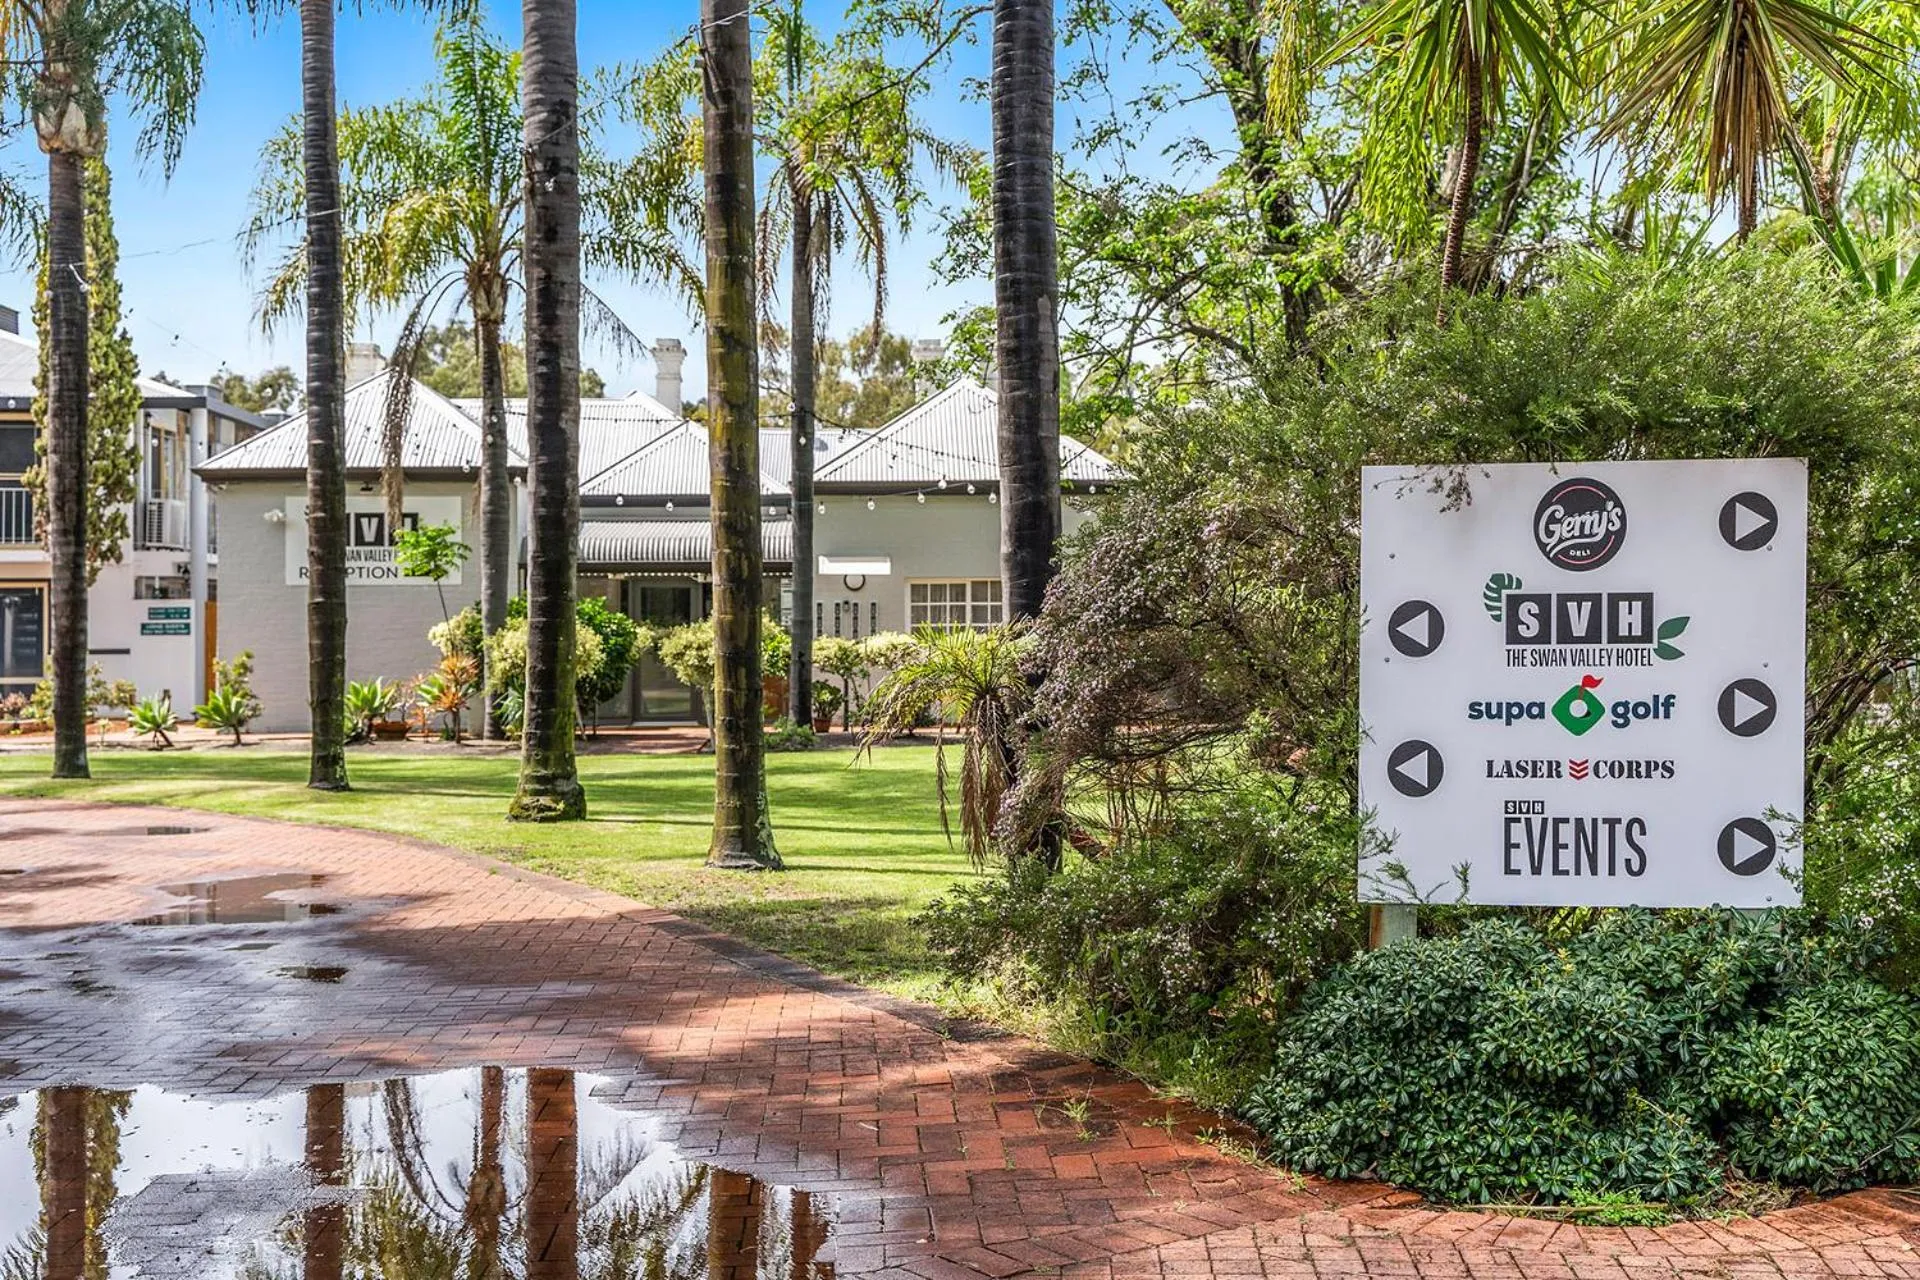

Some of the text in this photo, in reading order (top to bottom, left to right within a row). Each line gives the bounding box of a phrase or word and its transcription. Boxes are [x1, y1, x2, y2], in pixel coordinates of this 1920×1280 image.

[1539, 501, 1622, 557] Gerry's
[364, 549, 392, 562] VALLEY
[299, 566, 398, 579] RPTION
[1516, 599, 1644, 639] SVH
[1506, 648, 1653, 667] THE SWAN VALLEY HOTEL
[1467, 694, 1676, 728] supa golf
[1486, 759, 1675, 779] LASER CORPS
[1505, 801, 1544, 814] SVH
[1503, 817, 1647, 877] EVENTS
